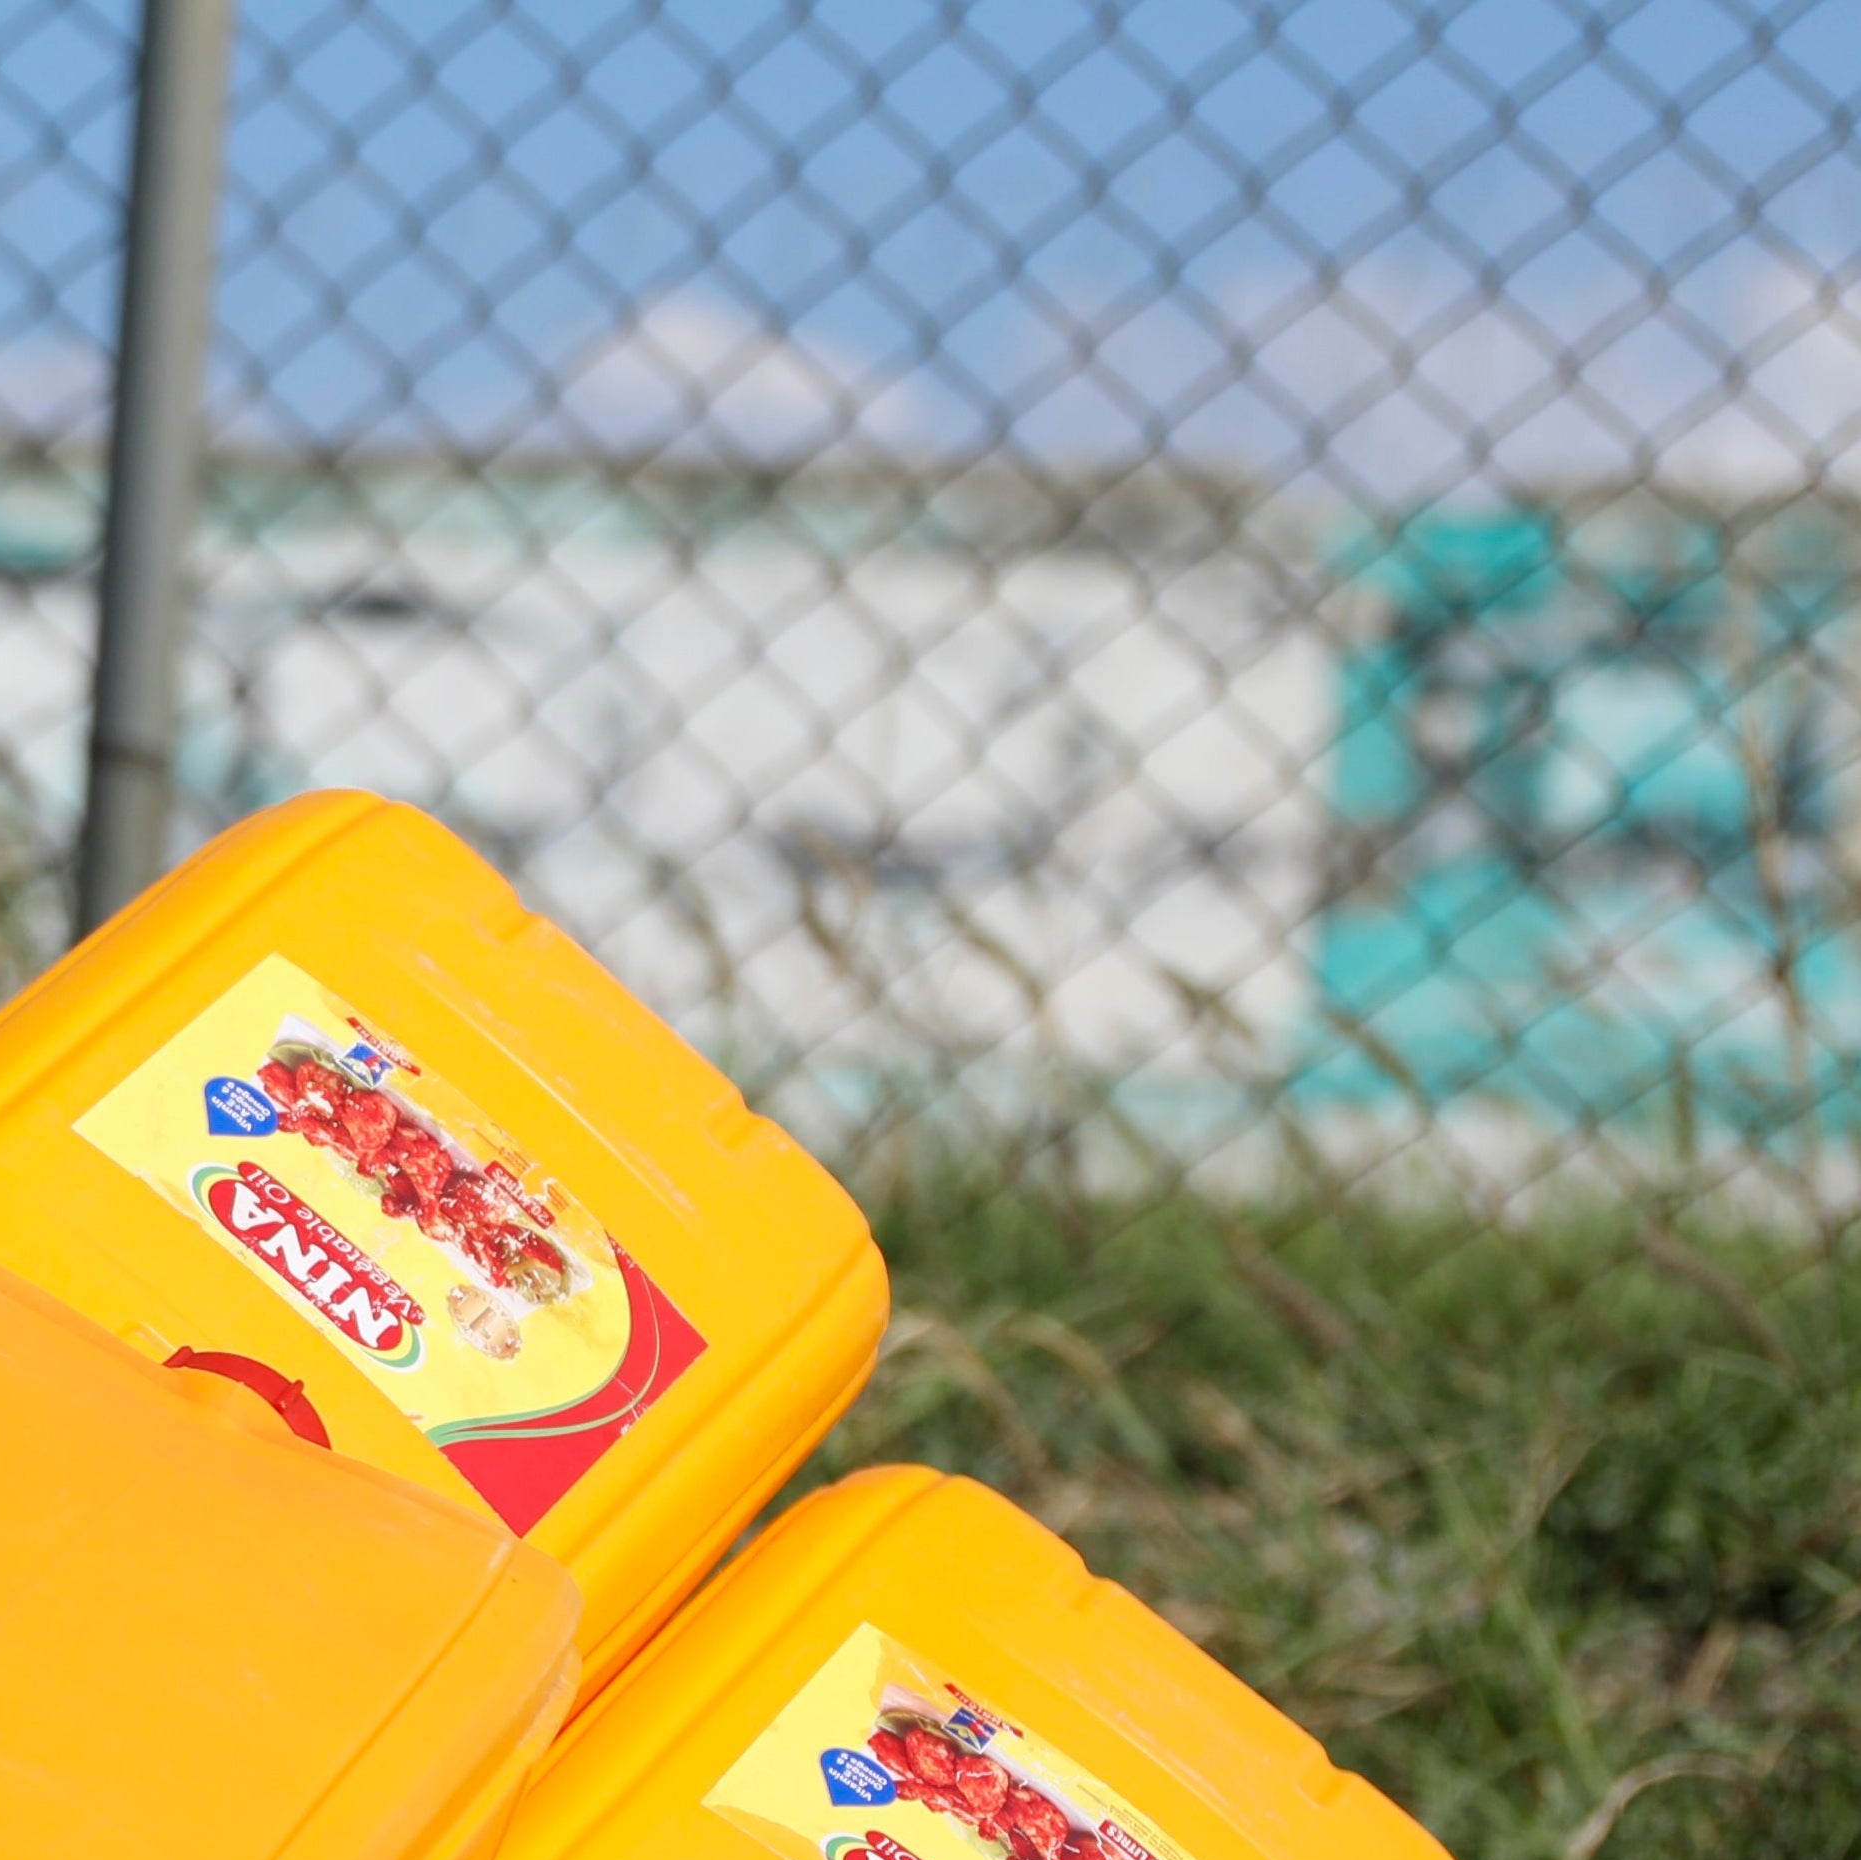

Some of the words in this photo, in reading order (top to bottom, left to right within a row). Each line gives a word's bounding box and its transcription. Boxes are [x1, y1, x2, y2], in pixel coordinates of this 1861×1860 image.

[209, 1095, 252, 1132] Vitamin
[228, 1091, 264, 1121] Omega
[234, 1085, 271, 1116] Omega
[245, 1167, 289, 1201] Oil
[233, 1179, 401, 1348] NINA
[297, 1205, 409, 1317] Vegetable
[828, 1766, 870, 1801] Vitamin
[845, 1761, 882, 1790] Omega
[849, 1756, 887, 1785] Omega
